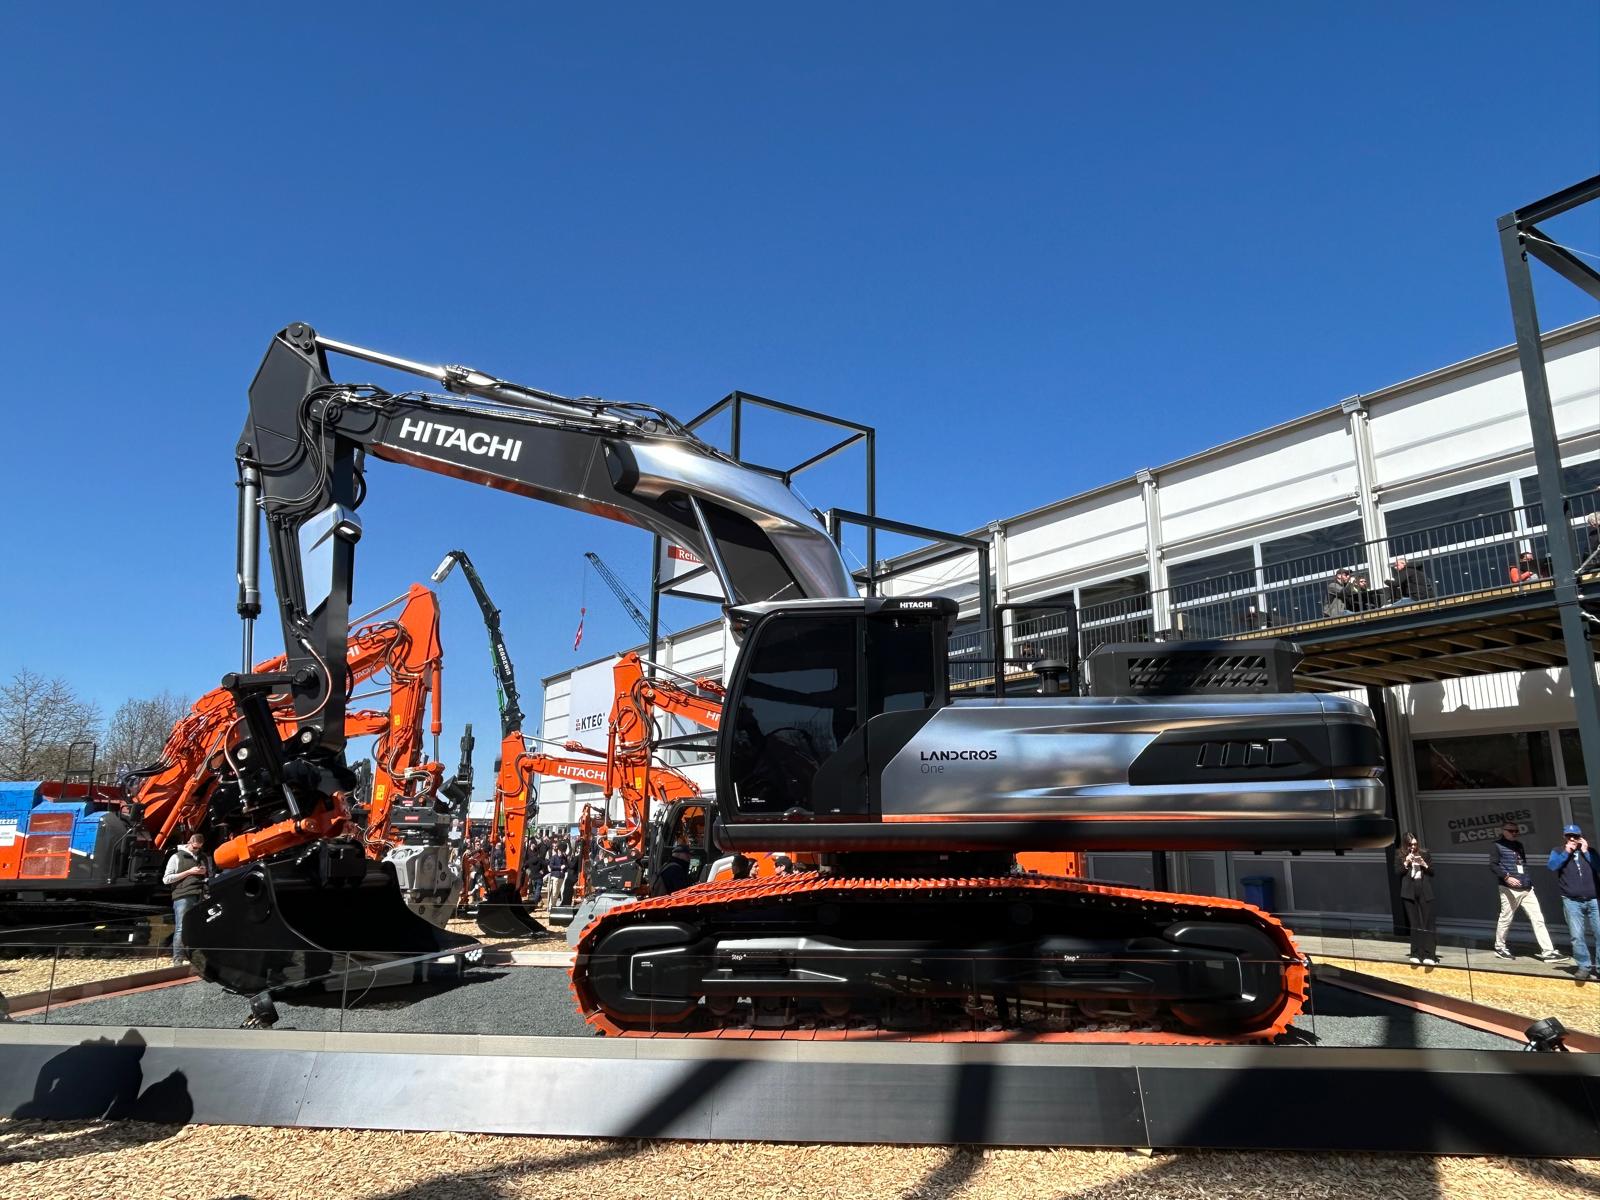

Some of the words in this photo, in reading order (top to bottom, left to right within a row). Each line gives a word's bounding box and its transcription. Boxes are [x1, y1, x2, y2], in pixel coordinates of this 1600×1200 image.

[399, 417, 523, 462] HITACHI
[900, 601, 933, 609] HITACHI
[581, 713, 603, 730] KTEG
[920, 750, 998, 761] LANDCROS
[557, 764, 607, 781] HITACHI
[920, 763, 945, 774] One
[1447, 809, 1532, 830] CHALLENGES
[1458, 823, 1529, 842] ACCEPD
